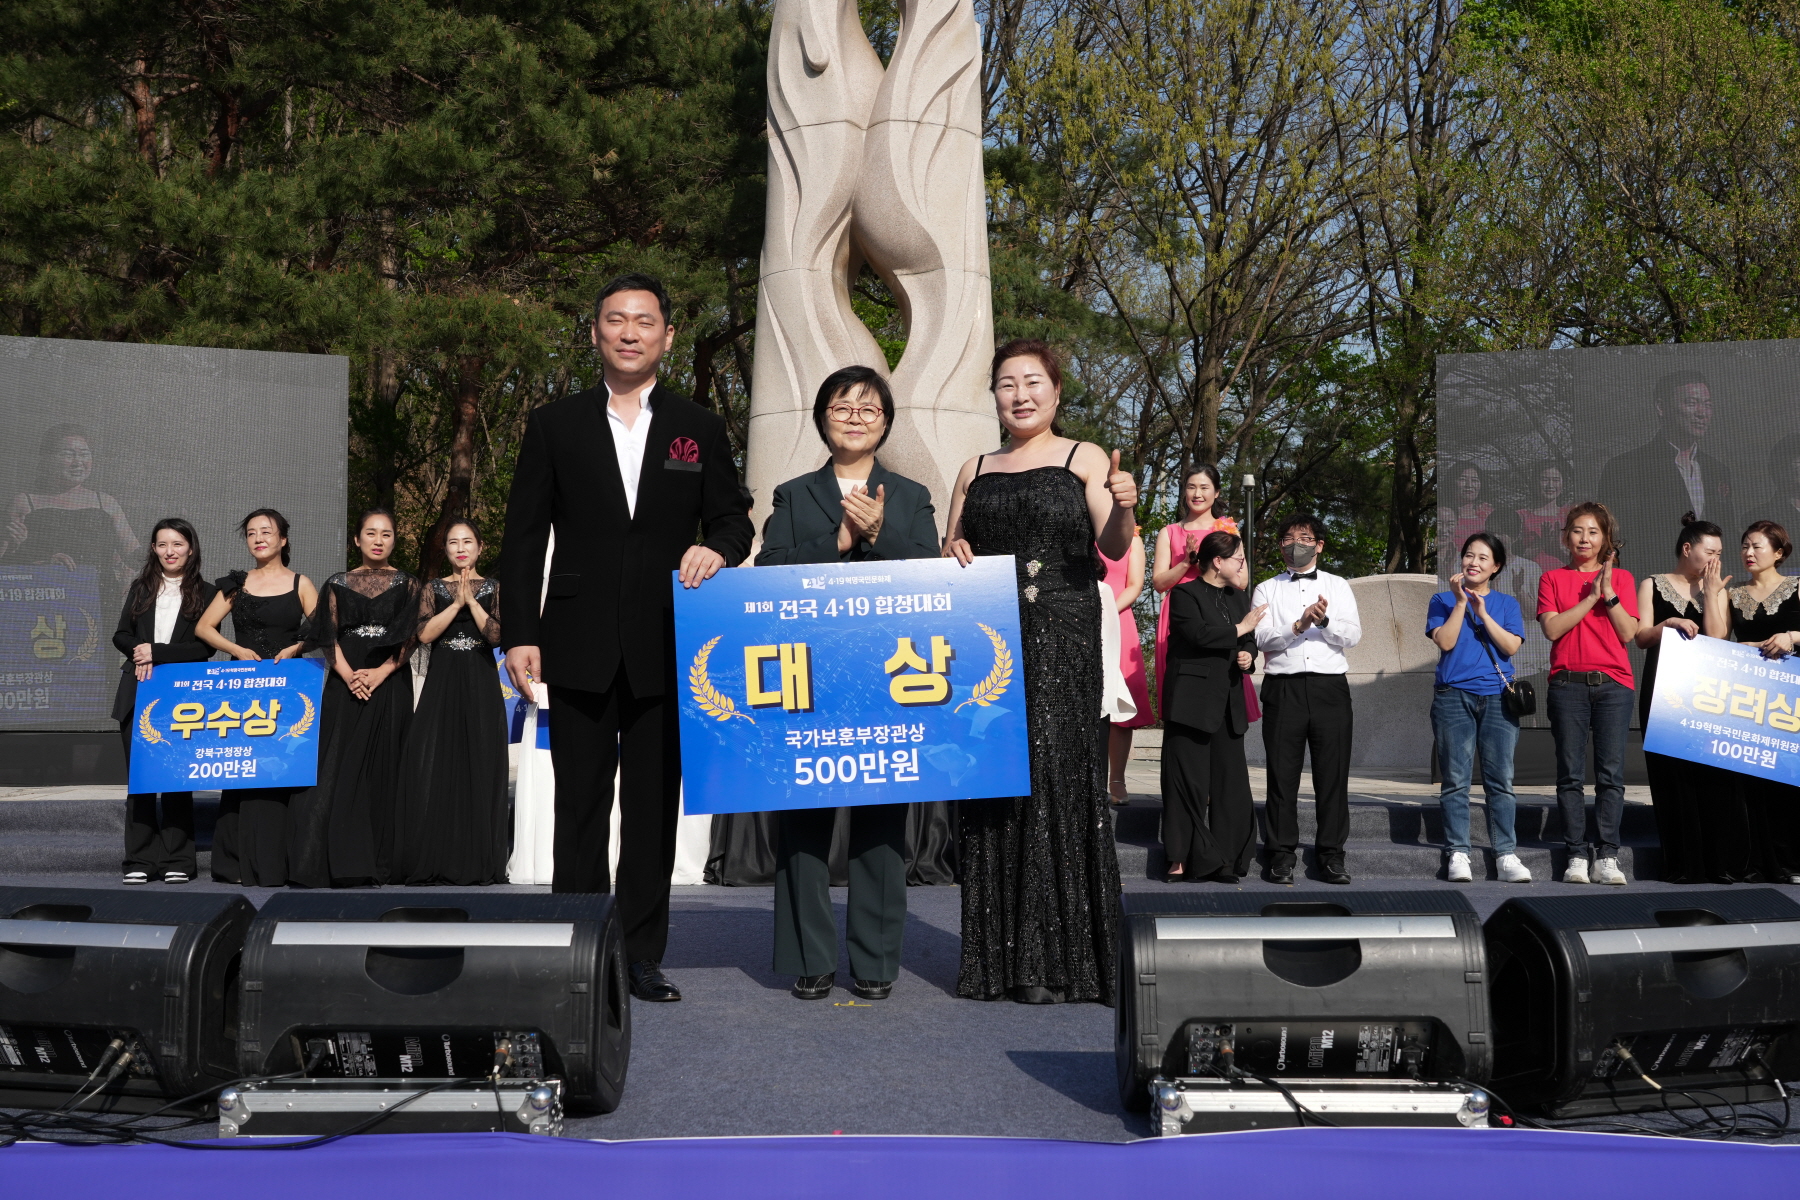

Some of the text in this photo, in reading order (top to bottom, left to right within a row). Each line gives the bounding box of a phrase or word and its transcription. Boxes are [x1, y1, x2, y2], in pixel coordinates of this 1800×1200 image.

[744, 593, 952, 620] 제1회 전국 4·19 합창대회
[30, 614, 67, 659] 상
[744, 635, 954, 711] 대 상
[1716, 656, 1738, 671] 전국
[1741, 663, 1767, 678] 4·19
[192, 679, 214, 691] 전국
[216, 678, 242, 690] 4·19
[244, 676, 287, 689] 합창대회
[170, 699, 282, 740] 우수상
[785, 723, 926, 749] 국가보훈부장관상
[195, 746, 252, 759] 강북구청장상
[1711, 739, 1777, 769] 100만원
[188, 759, 257, 778] 200만원
[794, 748, 920, 785] 500만원
[1278, 1027, 1288, 1063] Turbosound
[1321, 1029, 1335, 1049] M12
[1693, 1033, 1711, 1050] M12
[34, 1046, 51, 1064] M12
[399, 1054, 414, 1073] M12
[443, 1040, 456, 1076] Turbosound
